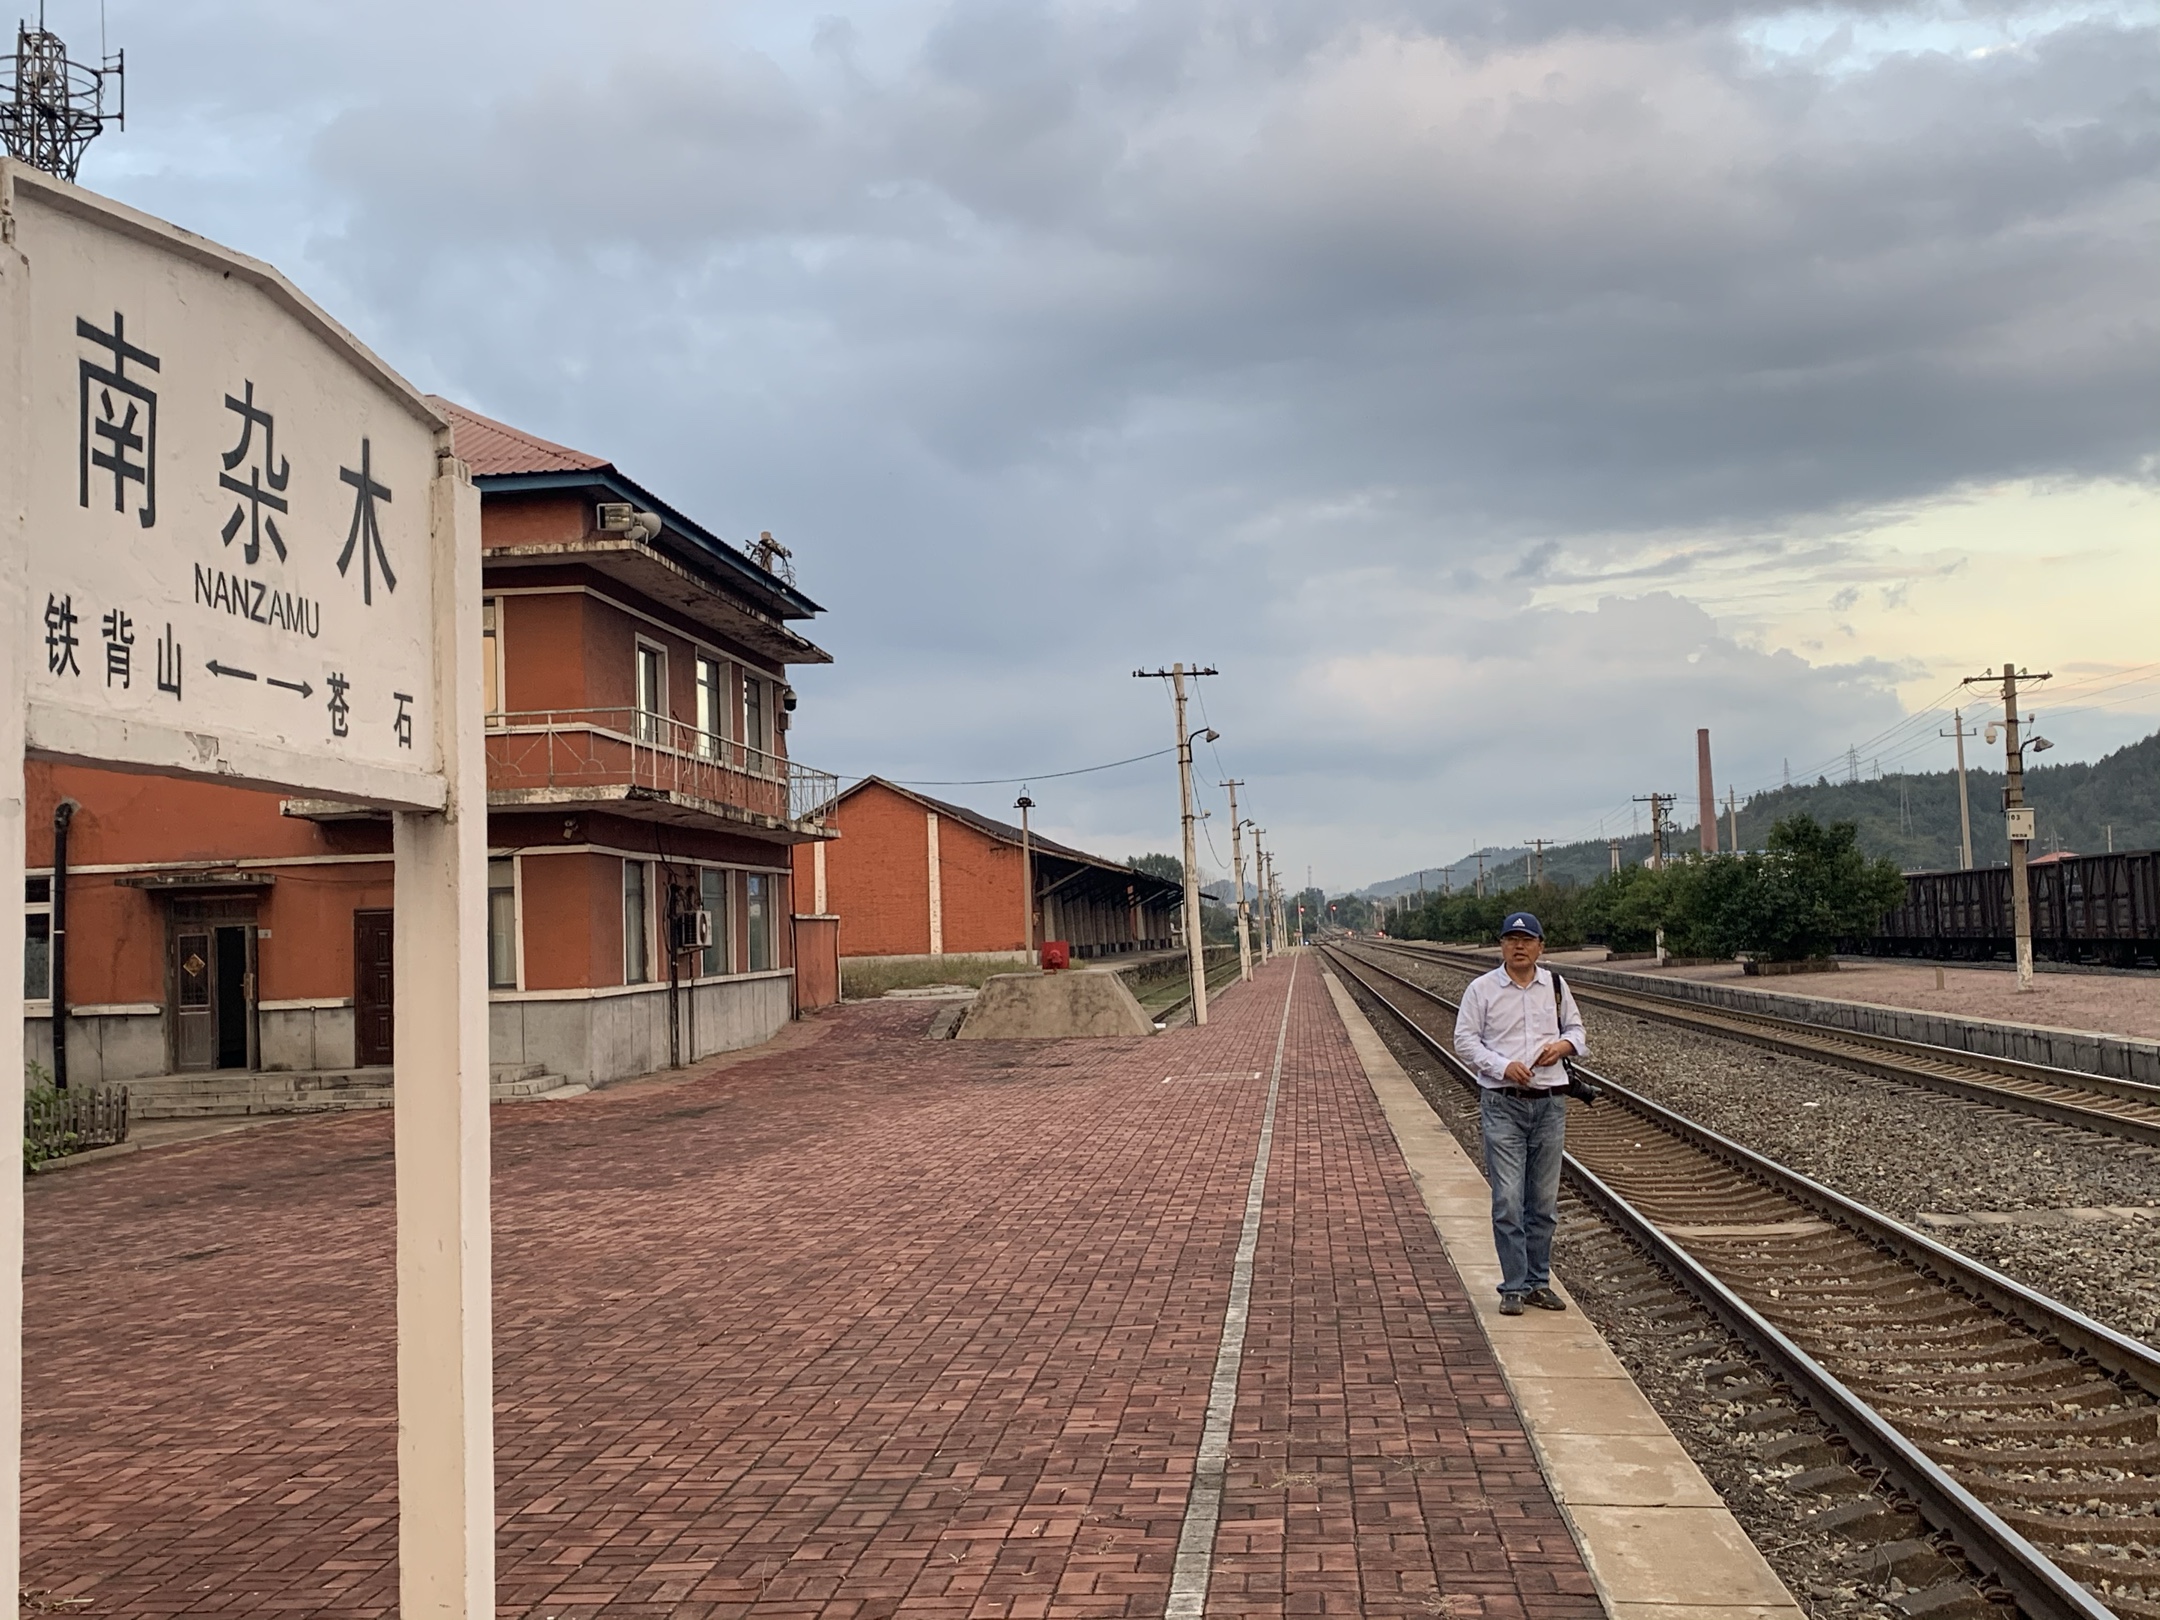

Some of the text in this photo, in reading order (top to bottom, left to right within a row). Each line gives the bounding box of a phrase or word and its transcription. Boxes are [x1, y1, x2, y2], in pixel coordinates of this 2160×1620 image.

[76, 310, 397, 606] 南杂木
[44, 592, 414, 750] 铁背山 苍石
[194, 562, 320, 639] NANZAMU
